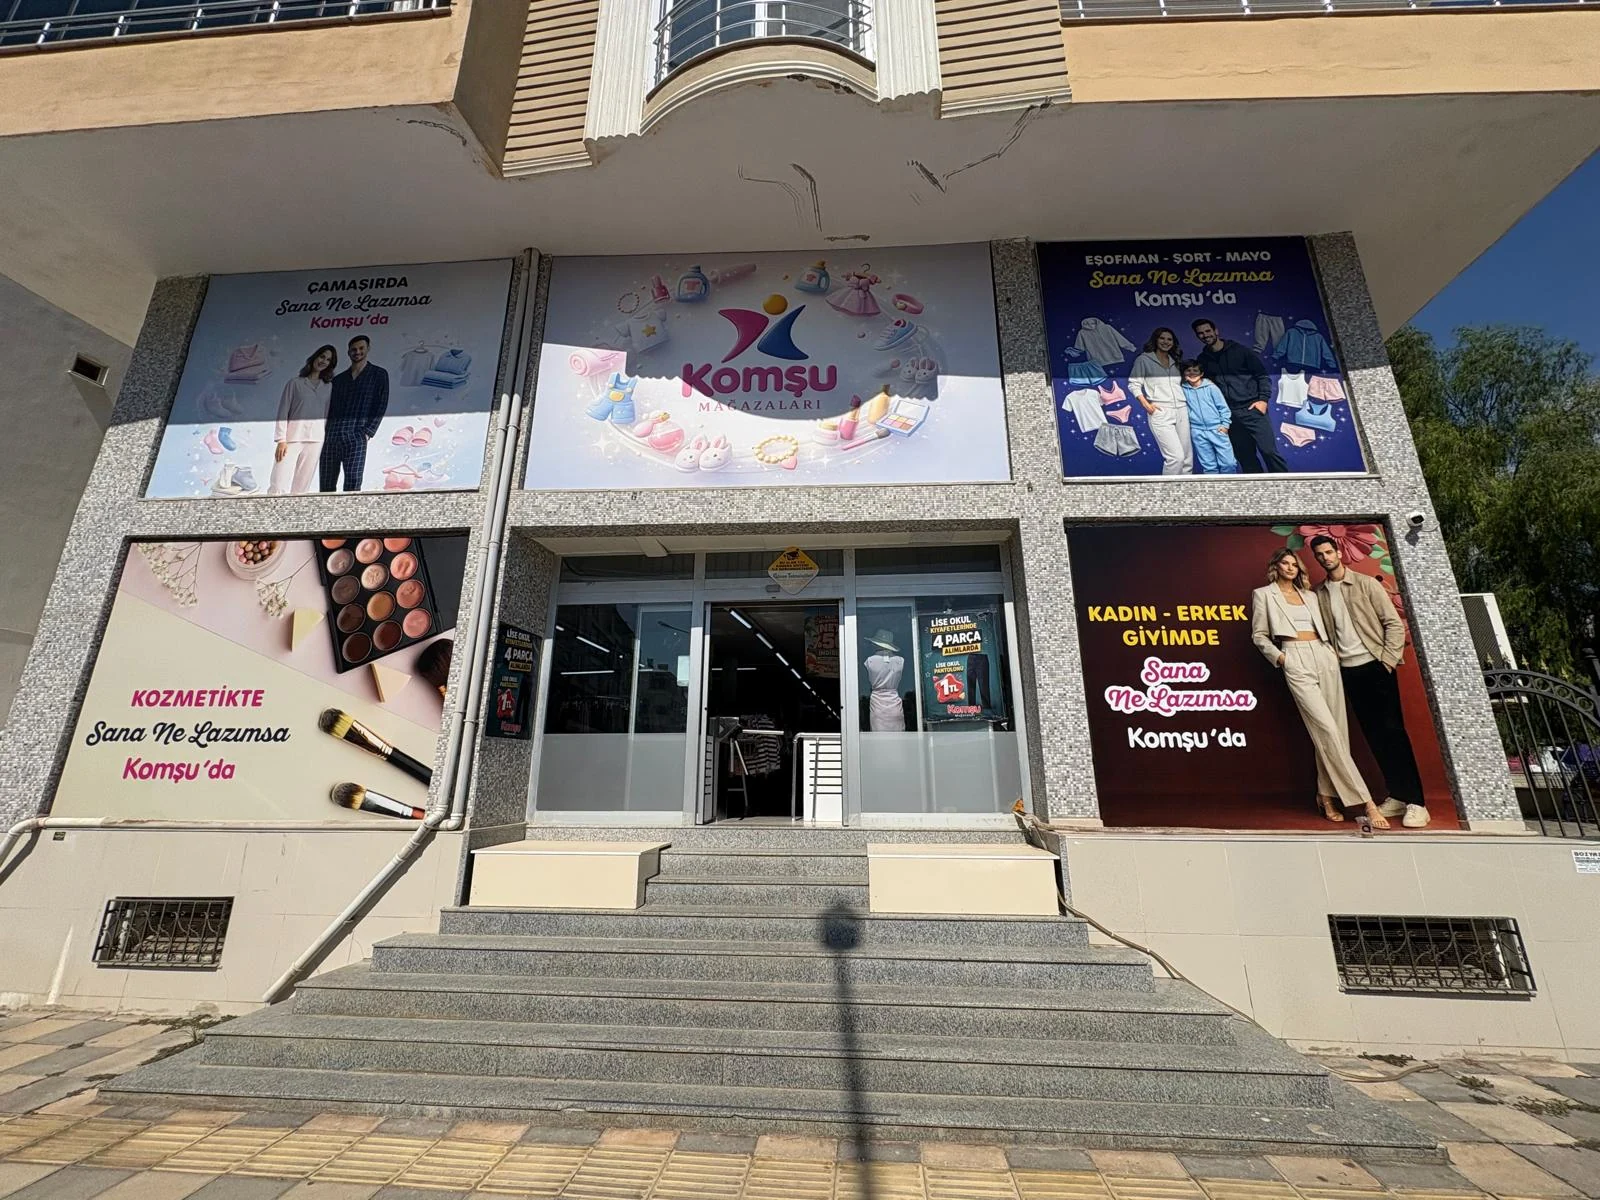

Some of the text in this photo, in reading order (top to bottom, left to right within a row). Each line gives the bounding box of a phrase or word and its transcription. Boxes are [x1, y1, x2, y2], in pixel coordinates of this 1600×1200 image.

[1085, 254, 1160, 267] EŞOFMAN
[1172, 252, 1212, 265] ŞORT
[1225, 251, 1272, 262] MAYO
[307, 276, 409, 295] ÇAMAŞIRDA
[1089, 268, 1274, 288] Sana Ne Lazımsa
[275, 294, 433, 316] Sana Ne Lazımsa
[1134, 289, 1237, 308] Komşu'da
[310, 313, 389, 329] Komşu'da
[681, 362, 838, 398] Komşu
[698, 399, 821, 412] MAĞAZALARI
[931, 615, 971, 627] LİSE OKUL
[1088, 605, 1157, 622] KADIN
[1176, 605, 1248, 621] ERKEK
[933, 631, 981, 649] 4 PARÇA
[1122, 625, 1220, 646] GİYİMDE
[504, 647, 533, 663] 4 PARÇA
[945, 645, 979, 655] ALIMLARDA
[1143, 659, 1208, 684] Sana
[131, 685, 265, 708] KOZMETİKTE
[1107, 687, 1254, 714] Ne Lazımsa
[86, 721, 291, 748] Sana Ne Lazımsa
[1127, 727, 1247, 753] Komşu'da
[122, 757, 236, 784] Komşu'da
